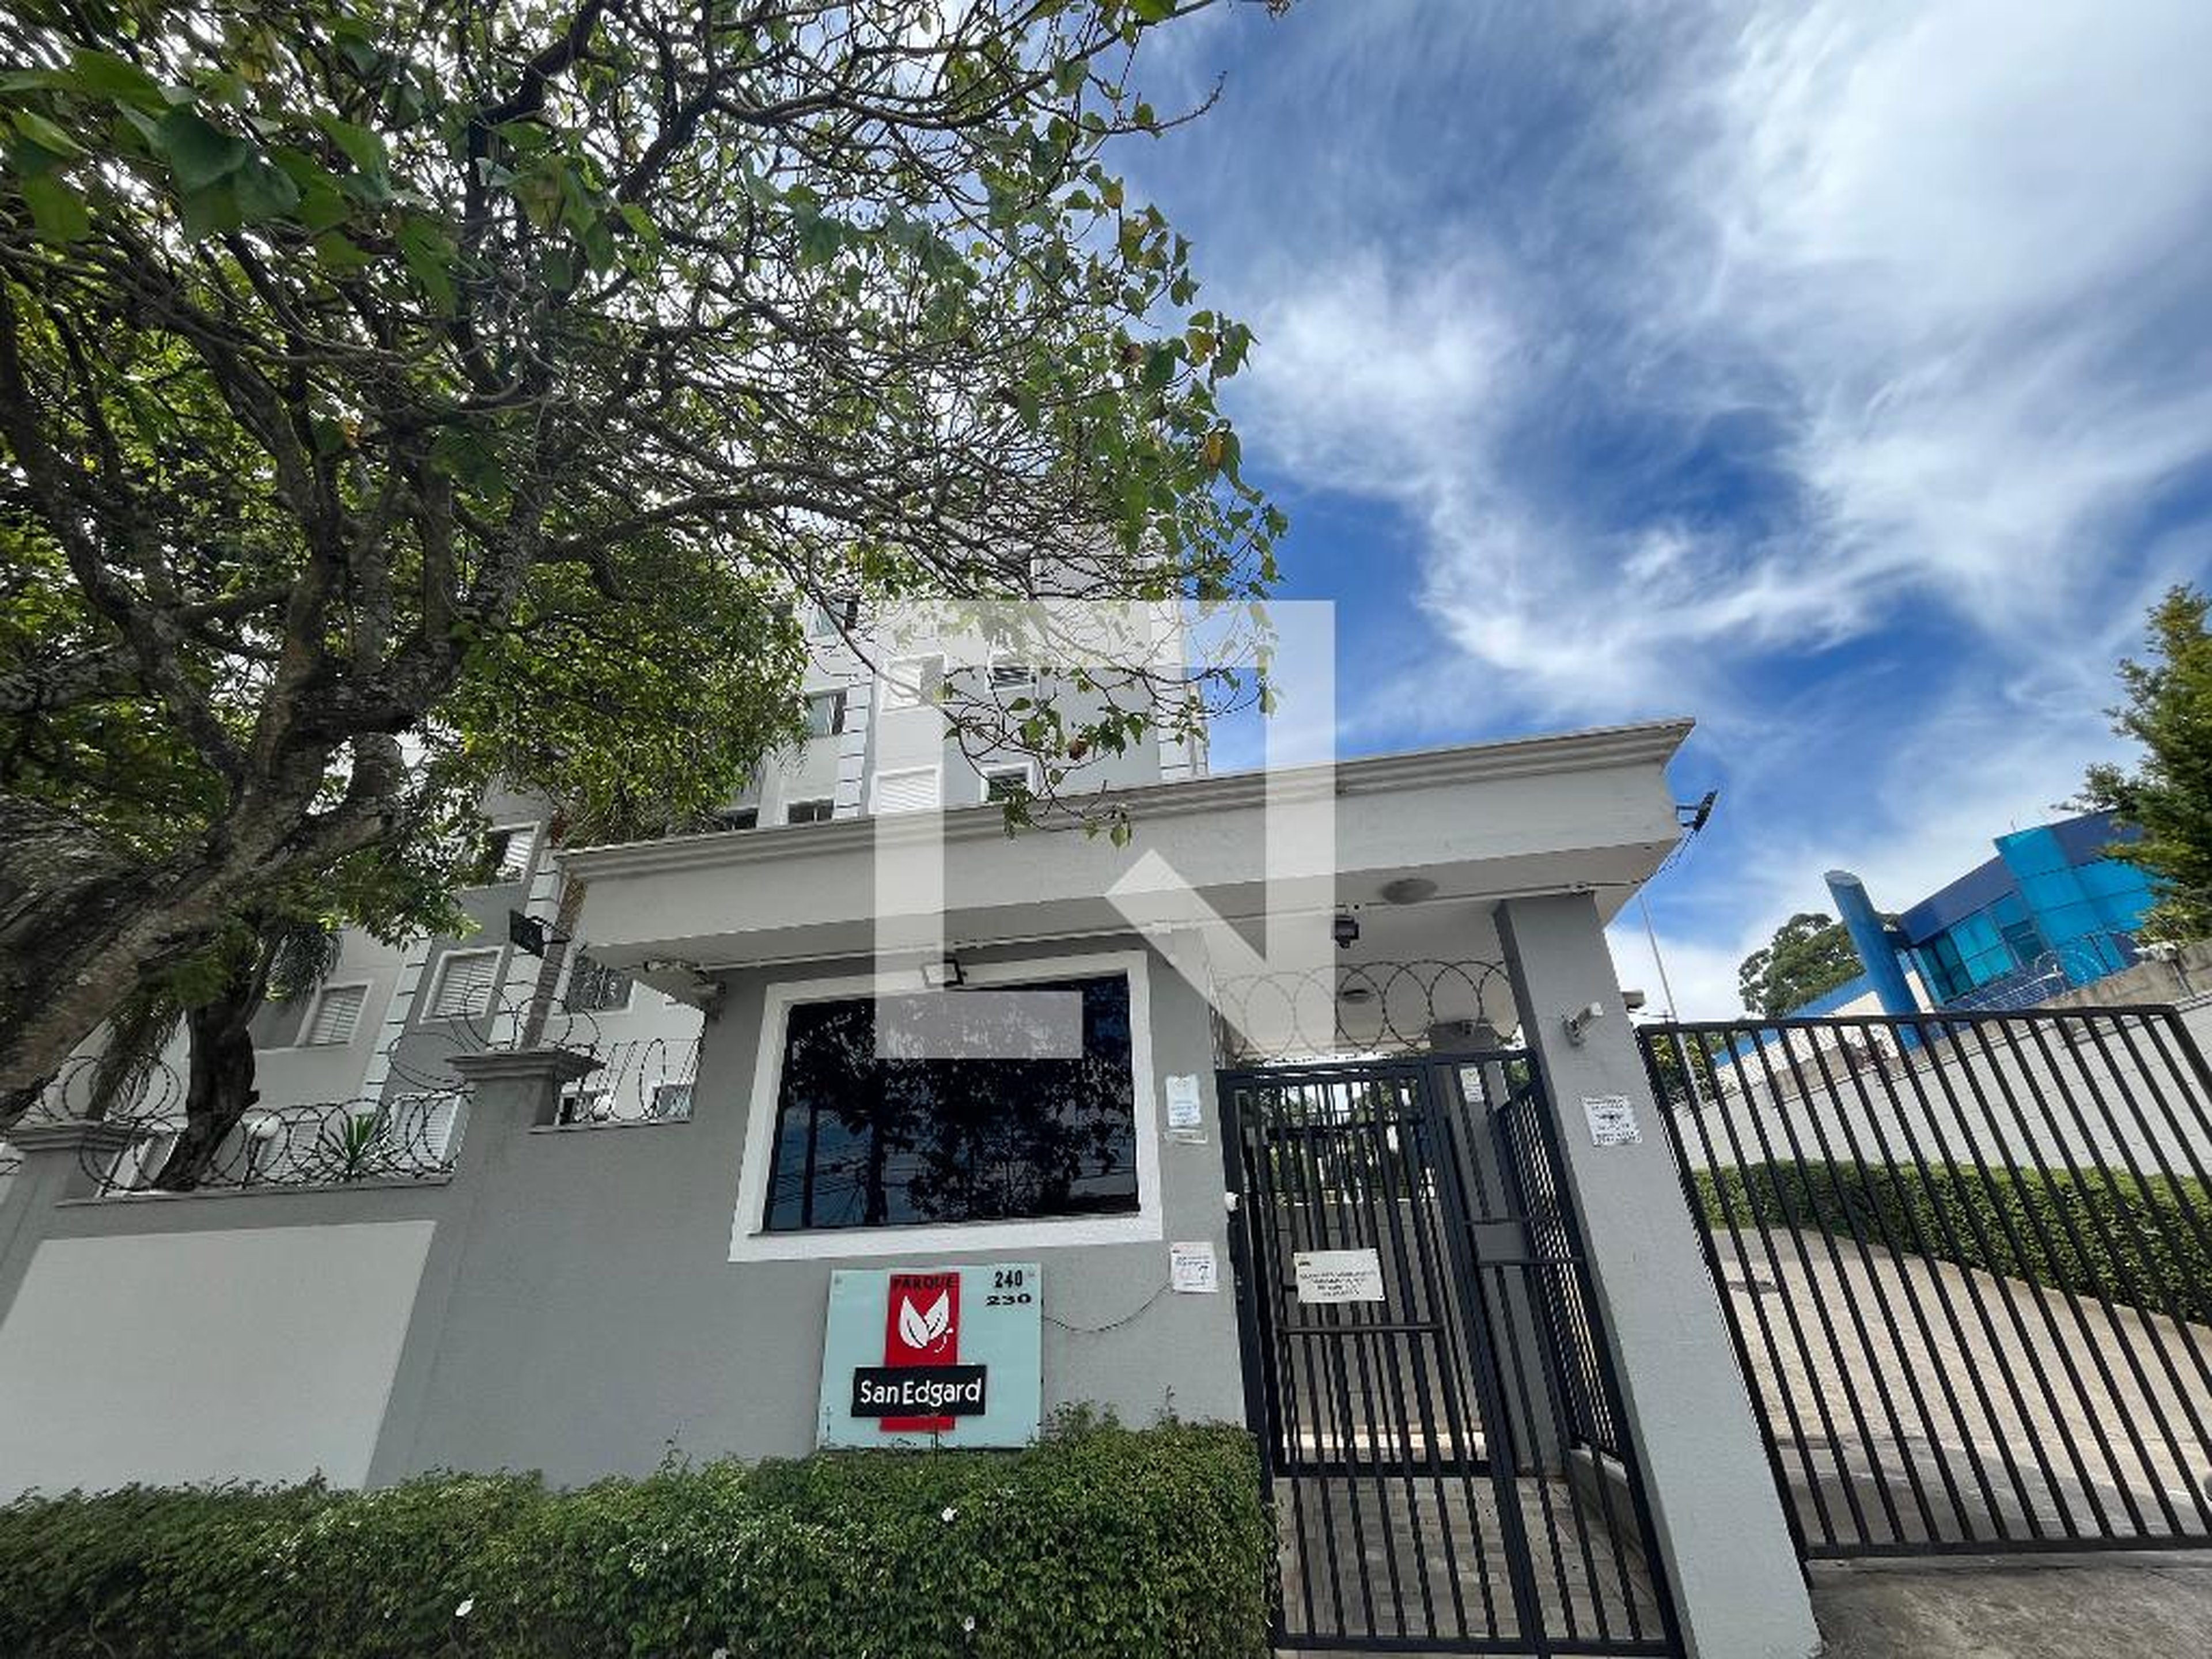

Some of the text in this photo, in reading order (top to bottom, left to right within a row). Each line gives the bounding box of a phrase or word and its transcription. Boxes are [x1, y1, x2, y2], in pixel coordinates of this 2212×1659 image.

[995, 1270, 1022, 1288] 240
[986, 1294, 1031, 1306] 230
[860, 1378, 982, 1407] San Edgard
